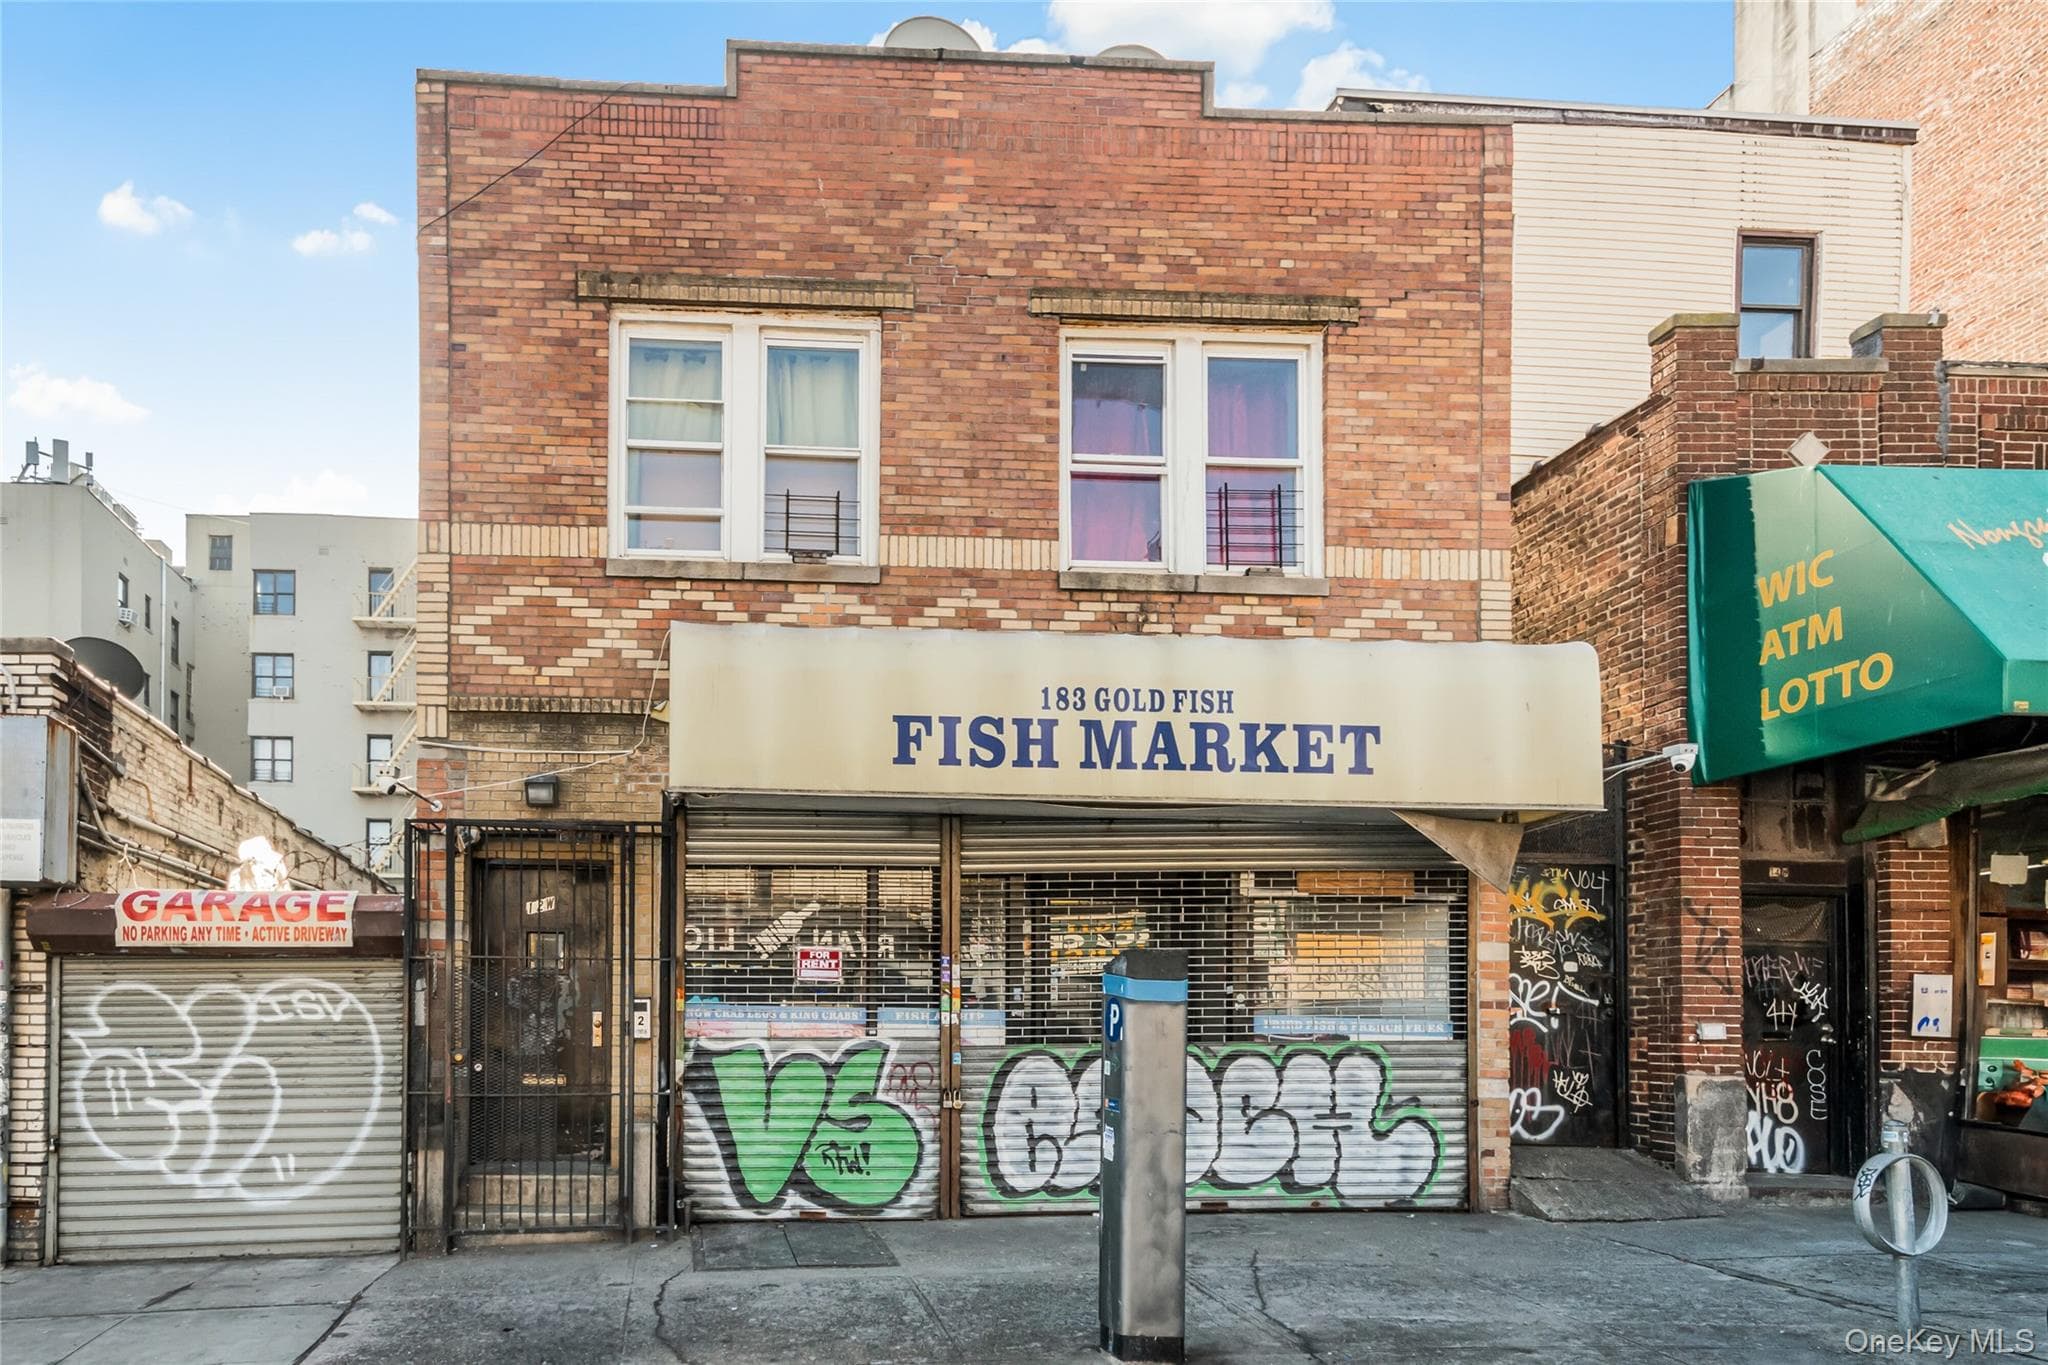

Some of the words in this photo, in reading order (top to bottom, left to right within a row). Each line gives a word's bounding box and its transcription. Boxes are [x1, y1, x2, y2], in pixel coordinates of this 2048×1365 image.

[1757, 549, 1834, 608] WIC
[1759, 606, 1843, 666] ATM
[1041, 686, 1086, 712] 183
[1094, 687, 1165, 713] GOLD
[1173, 689, 1235, 714] FISH
[1760, 652, 1894, 721] LOTTO
[892, 715, 1060, 770] FISH
[1079, 719, 1381, 775] MARKET
[122, 889, 352, 922] GARAGE
[122, 926, 138, 942] NO
[140, 926, 188, 942] PARKING
[190, 926, 212, 942] ANY
[215, 926, 241, 942] TIME
[252, 926, 291, 942] ACTIVE
[293, 926, 347, 942] DRIVEWAY
[802, 960, 838, 969] RENT
[809, 951, 830, 959] FOR
